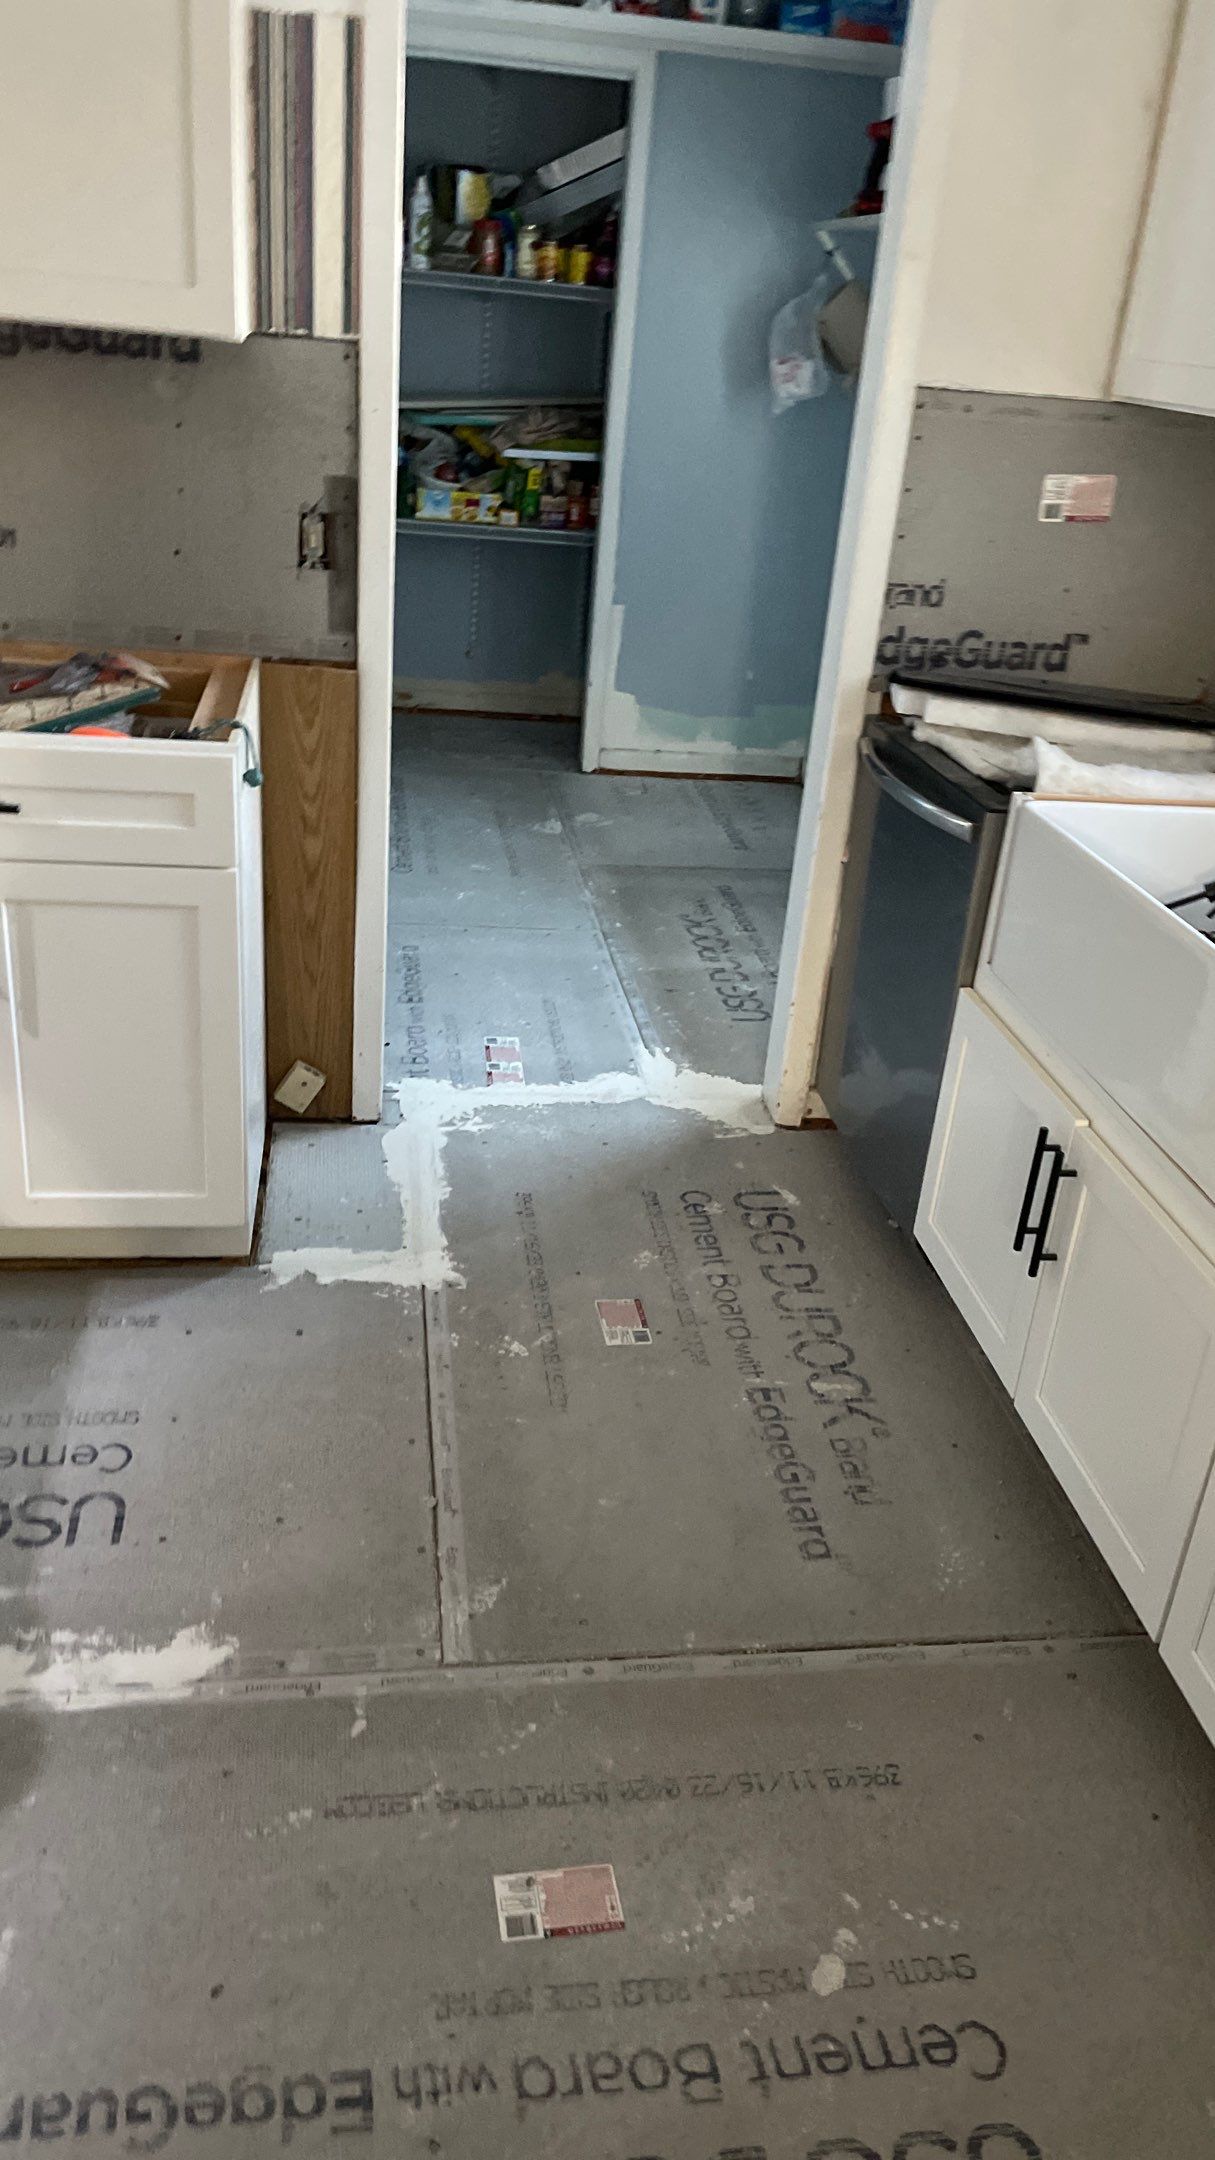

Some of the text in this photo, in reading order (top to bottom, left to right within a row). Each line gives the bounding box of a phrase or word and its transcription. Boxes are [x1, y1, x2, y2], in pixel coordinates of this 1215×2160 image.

[680, 1190, 732, 1266] Cement
[733, 1190, 807, 1255] USG
[707, 1273, 758, 1341] Board
[735, 1343, 765, 1379] with
[746, 1387, 832, 1560] EdgeGuard
[0, 1491, 126, 1547] US
[394, 2060, 499, 2108] with
[512, 2041, 723, 2124] Board
[738, 2019, 1007, 2100] Cement
